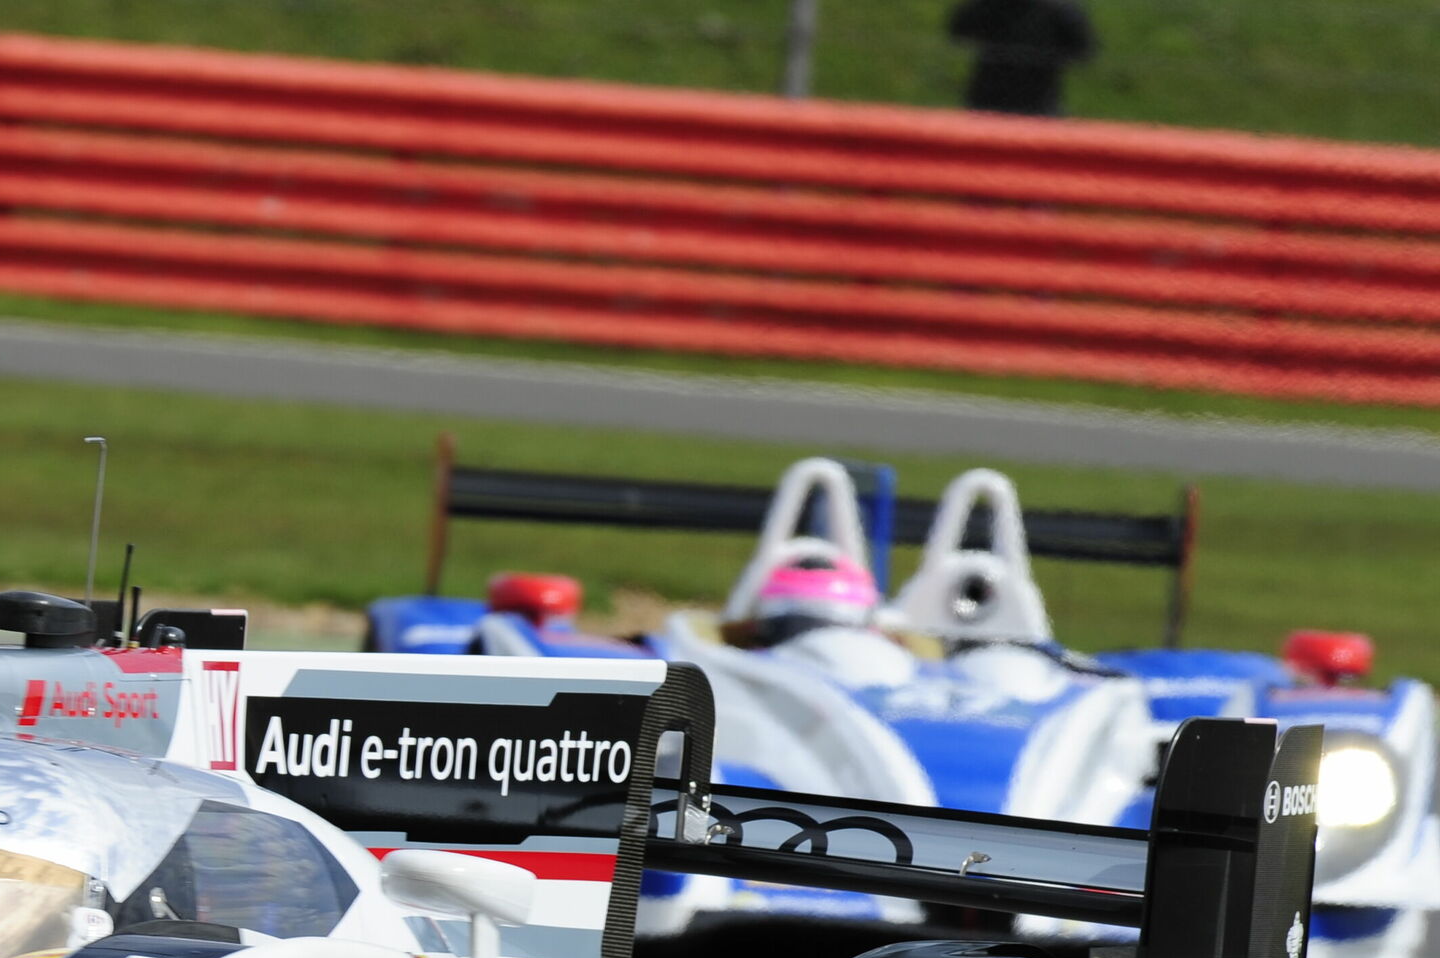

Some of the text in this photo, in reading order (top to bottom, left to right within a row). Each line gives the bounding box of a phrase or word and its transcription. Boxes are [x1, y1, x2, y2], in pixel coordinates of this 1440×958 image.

[49, 680, 160, 729] Audi Sport
[256, 715, 632, 797] Audi e-tron quattro
[1282, 784, 1318, 817] BOSCH
